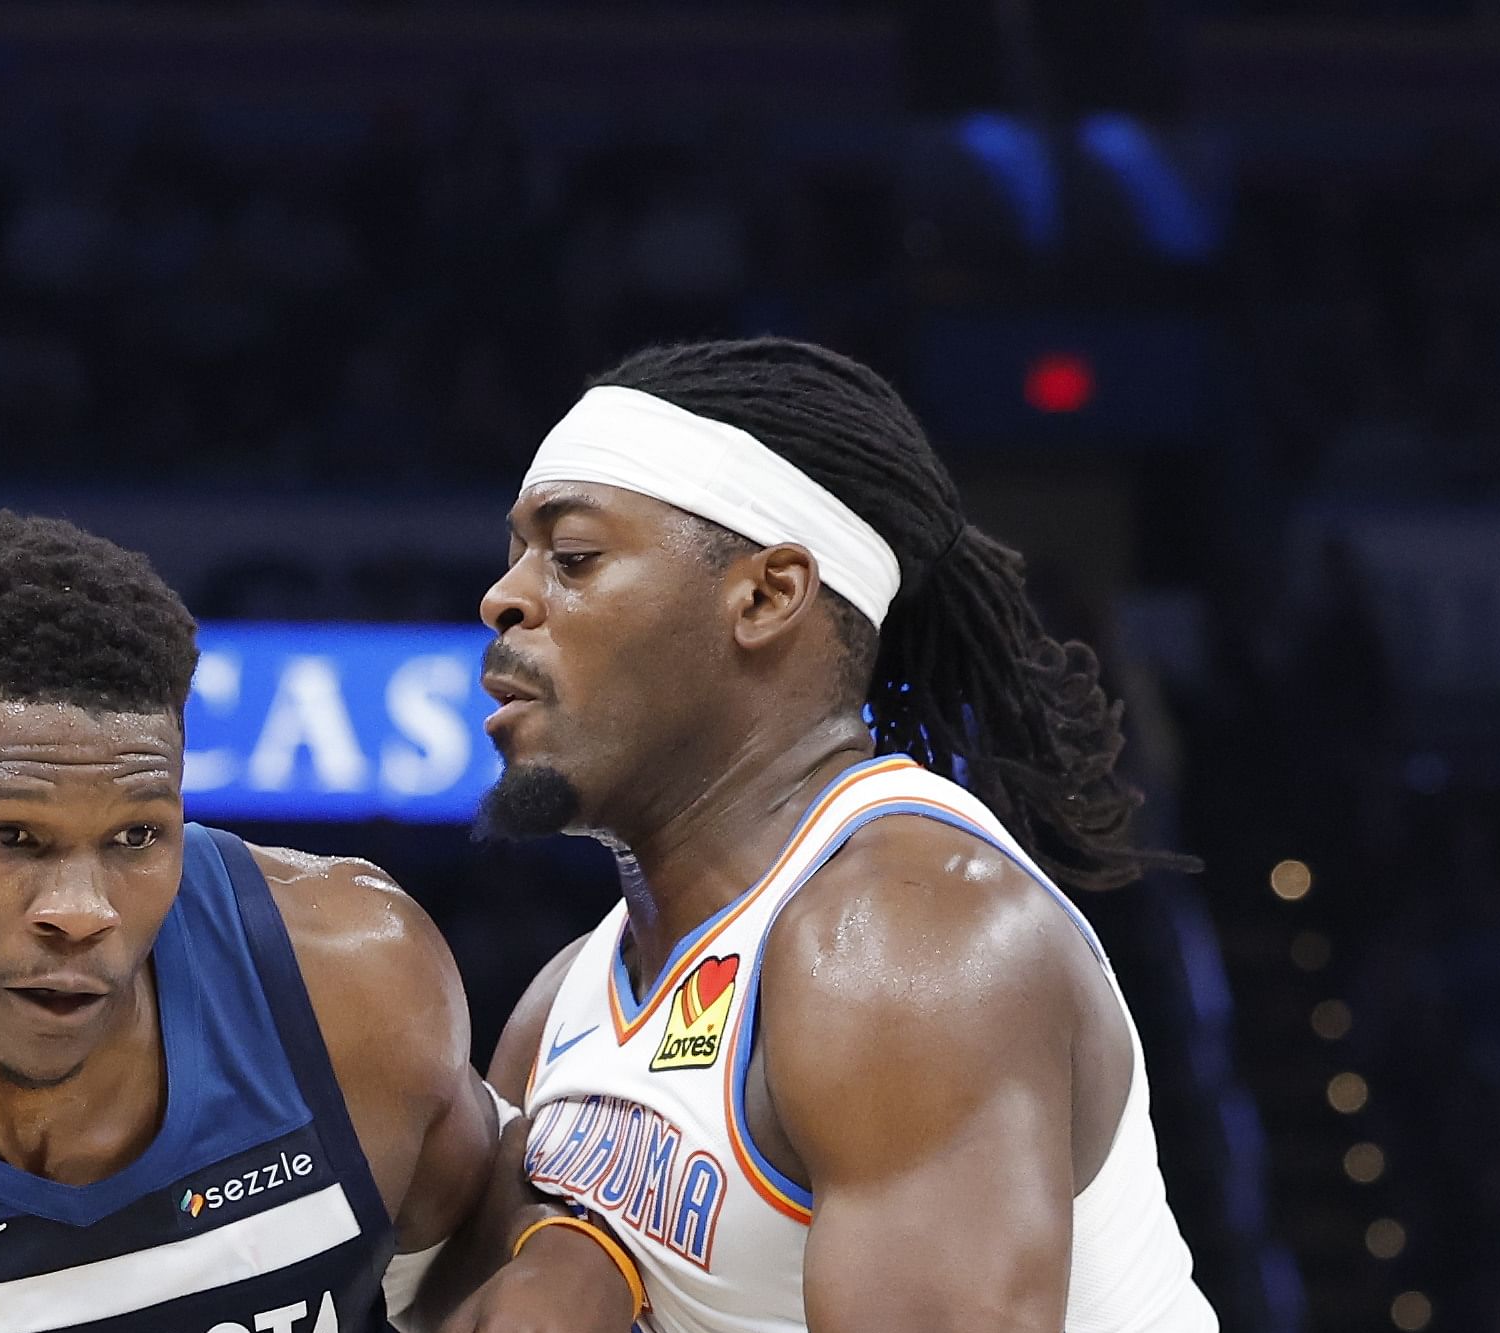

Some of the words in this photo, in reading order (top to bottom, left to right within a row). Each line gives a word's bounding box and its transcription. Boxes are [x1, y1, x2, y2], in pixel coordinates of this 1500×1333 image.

[178, 650, 478, 797] CAS
[205, 1152, 313, 1209] sezzle
[525, 1095, 728, 1272] LAHOMA
